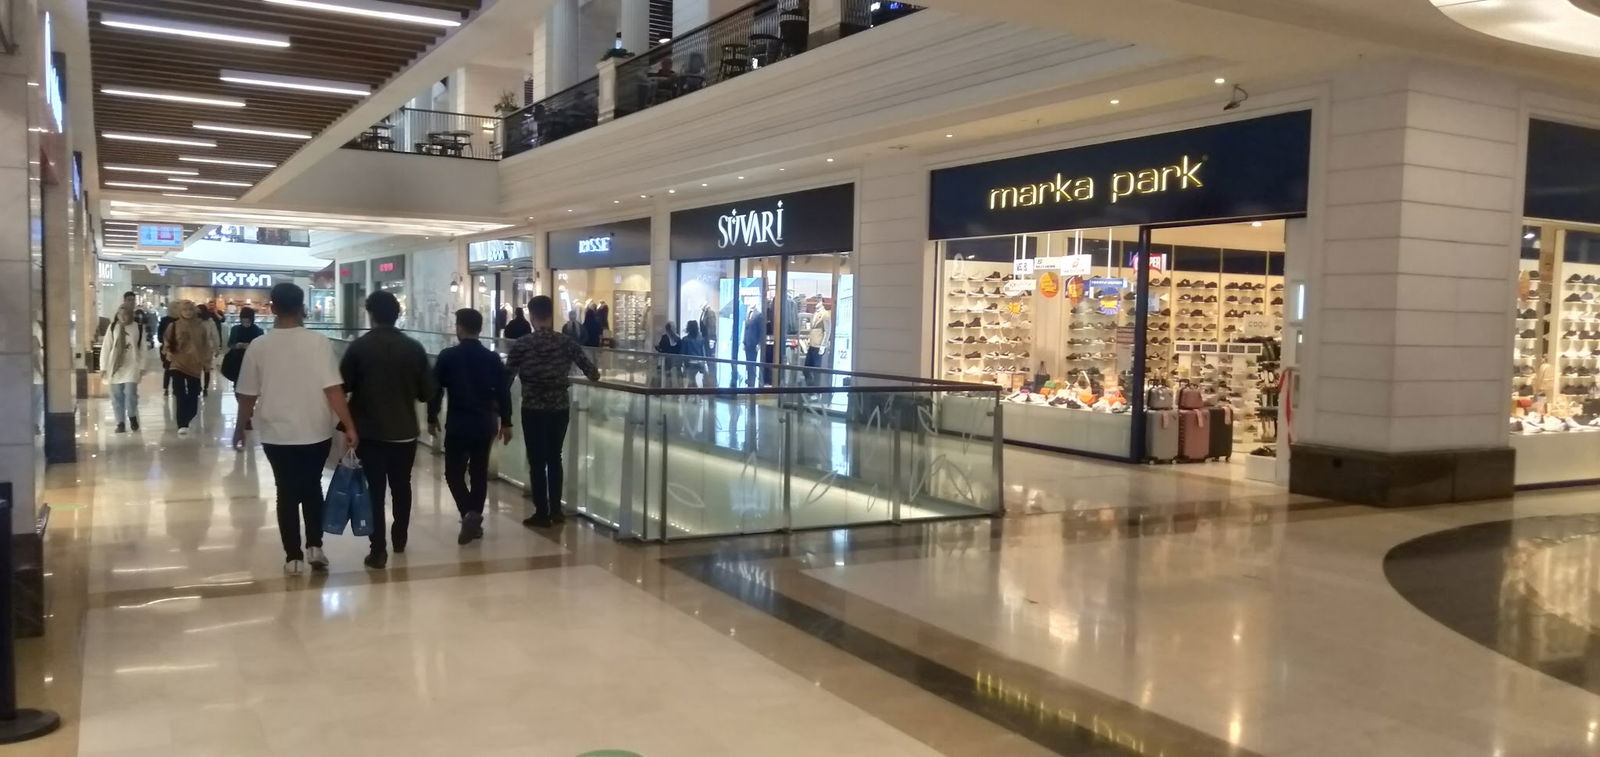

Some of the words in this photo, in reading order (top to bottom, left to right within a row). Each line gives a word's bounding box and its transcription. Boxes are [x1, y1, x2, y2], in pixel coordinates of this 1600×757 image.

[990, 173, 1094, 210] marka
[1112, 155, 1204, 203] park
[211, 271, 272, 287] KOTON
